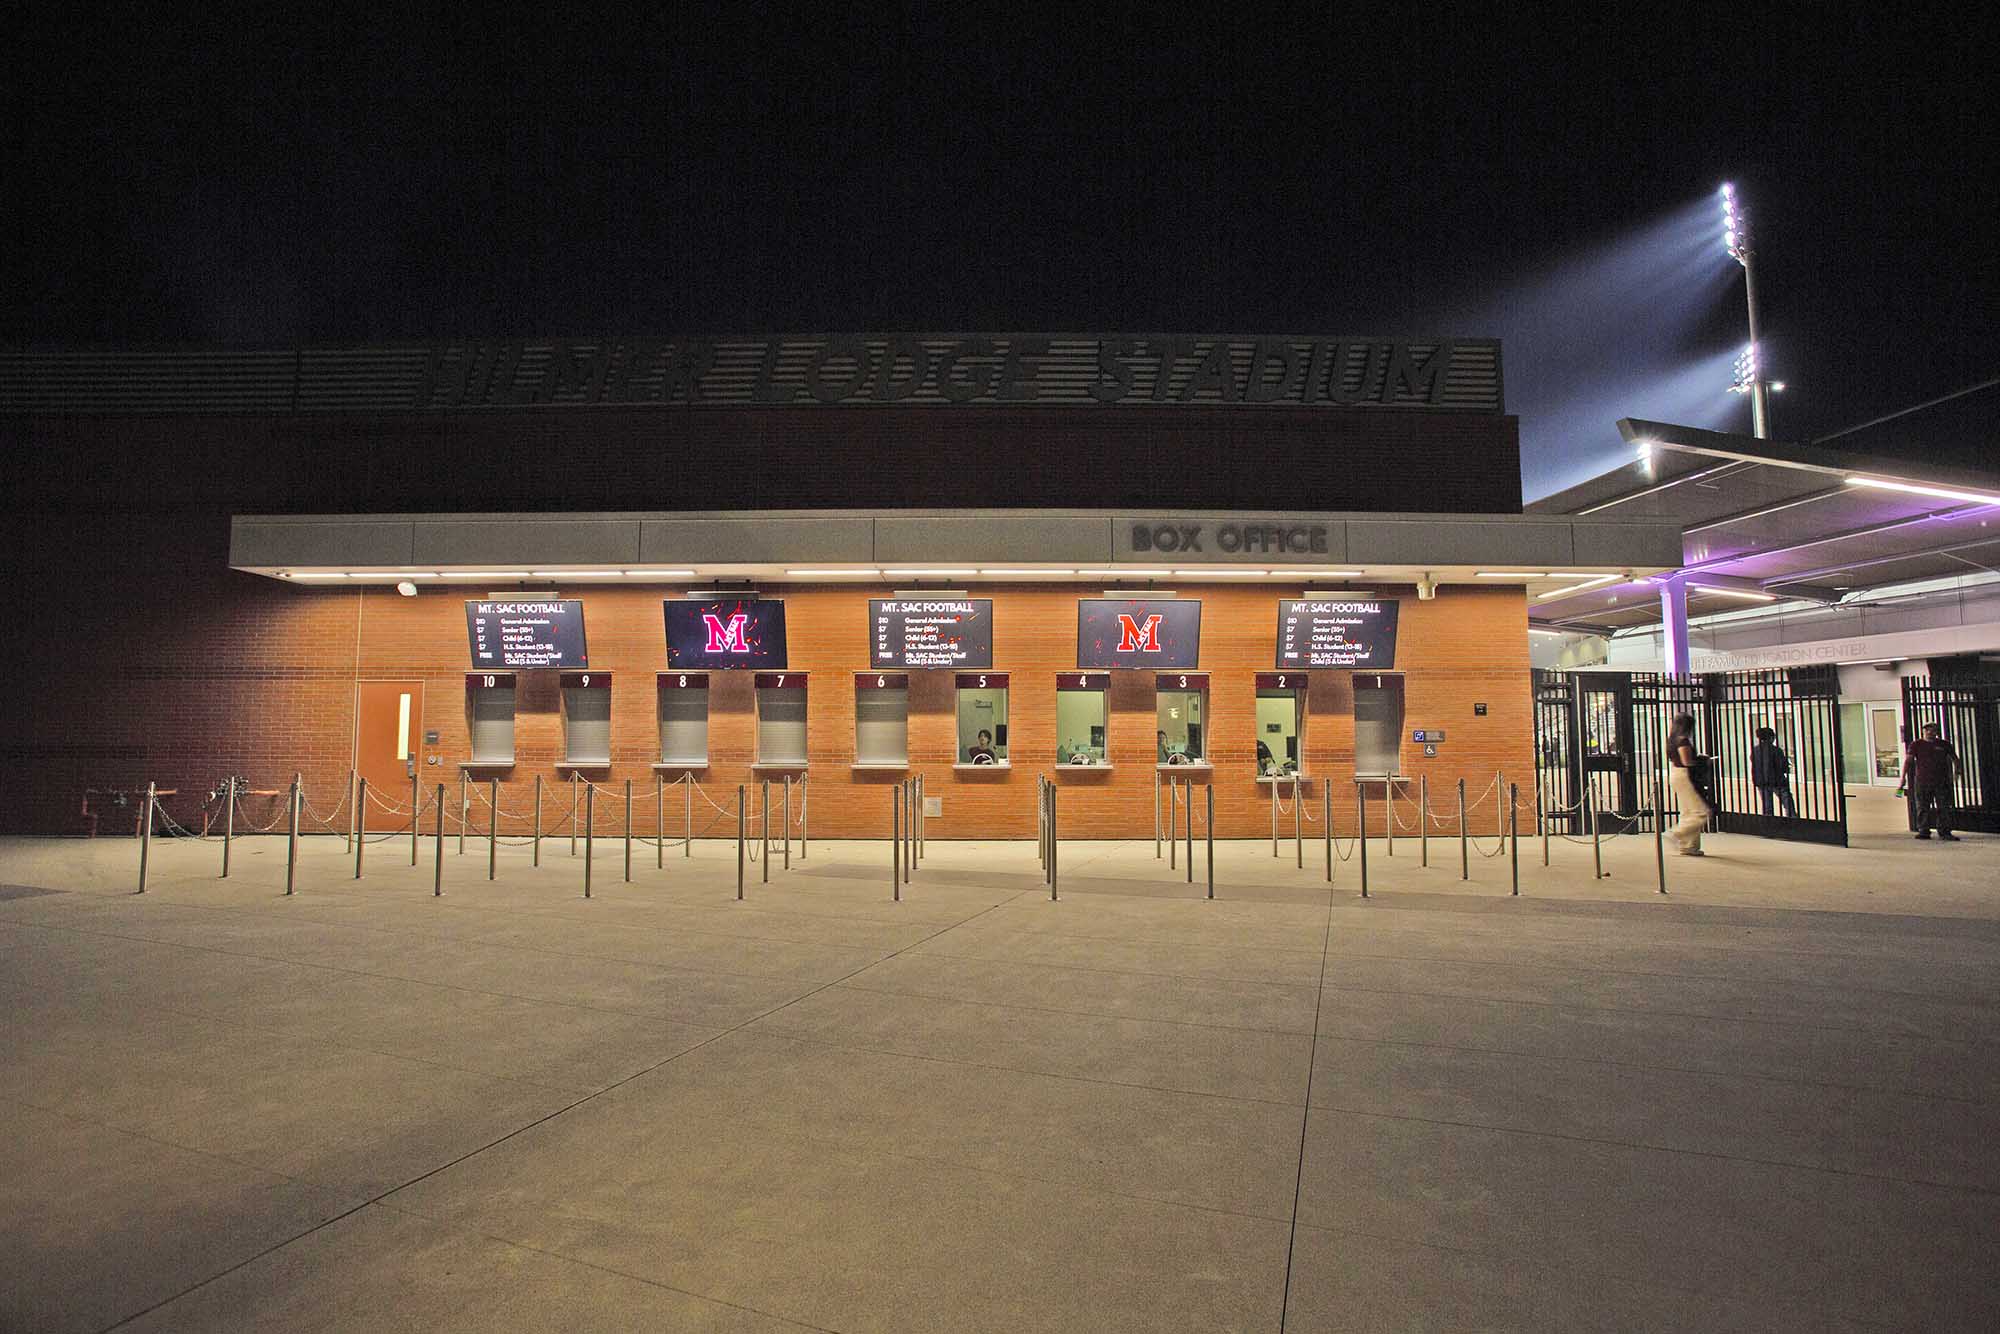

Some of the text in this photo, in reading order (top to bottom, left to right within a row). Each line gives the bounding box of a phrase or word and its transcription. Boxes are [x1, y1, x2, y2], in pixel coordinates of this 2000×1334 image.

[752, 335, 1050, 403] LODGE
[1086, 336, 1455, 403] STADIUM
[1132, 525, 1328, 553] BOX OFFICE
[478, 605, 565, 613] MT. SAC FOOTBALL
[882, 603, 973, 612] MT. SAC FOOTBALL
[1292, 604, 1380, 612] MT. SAC FOOTBALL
[703, 615, 749, 652] M
[1117, 614, 1163, 652] M
[1815, 643, 1867, 659] CENTER
[483, 676, 495, 688] 10
[582, 676, 590, 688] 9
[679, 676, 686, 688] 8
[777, 676, 785, 688] 7
[877, 676, 885, 688] 6
[979, 676, 986, 688] 5
[1079, 676, 1086, 688] 4
[1180, 676, 1186, 688] 3
[1278, 676, 1286, 688] 2
[1376, 676, 1382, 688] 1
